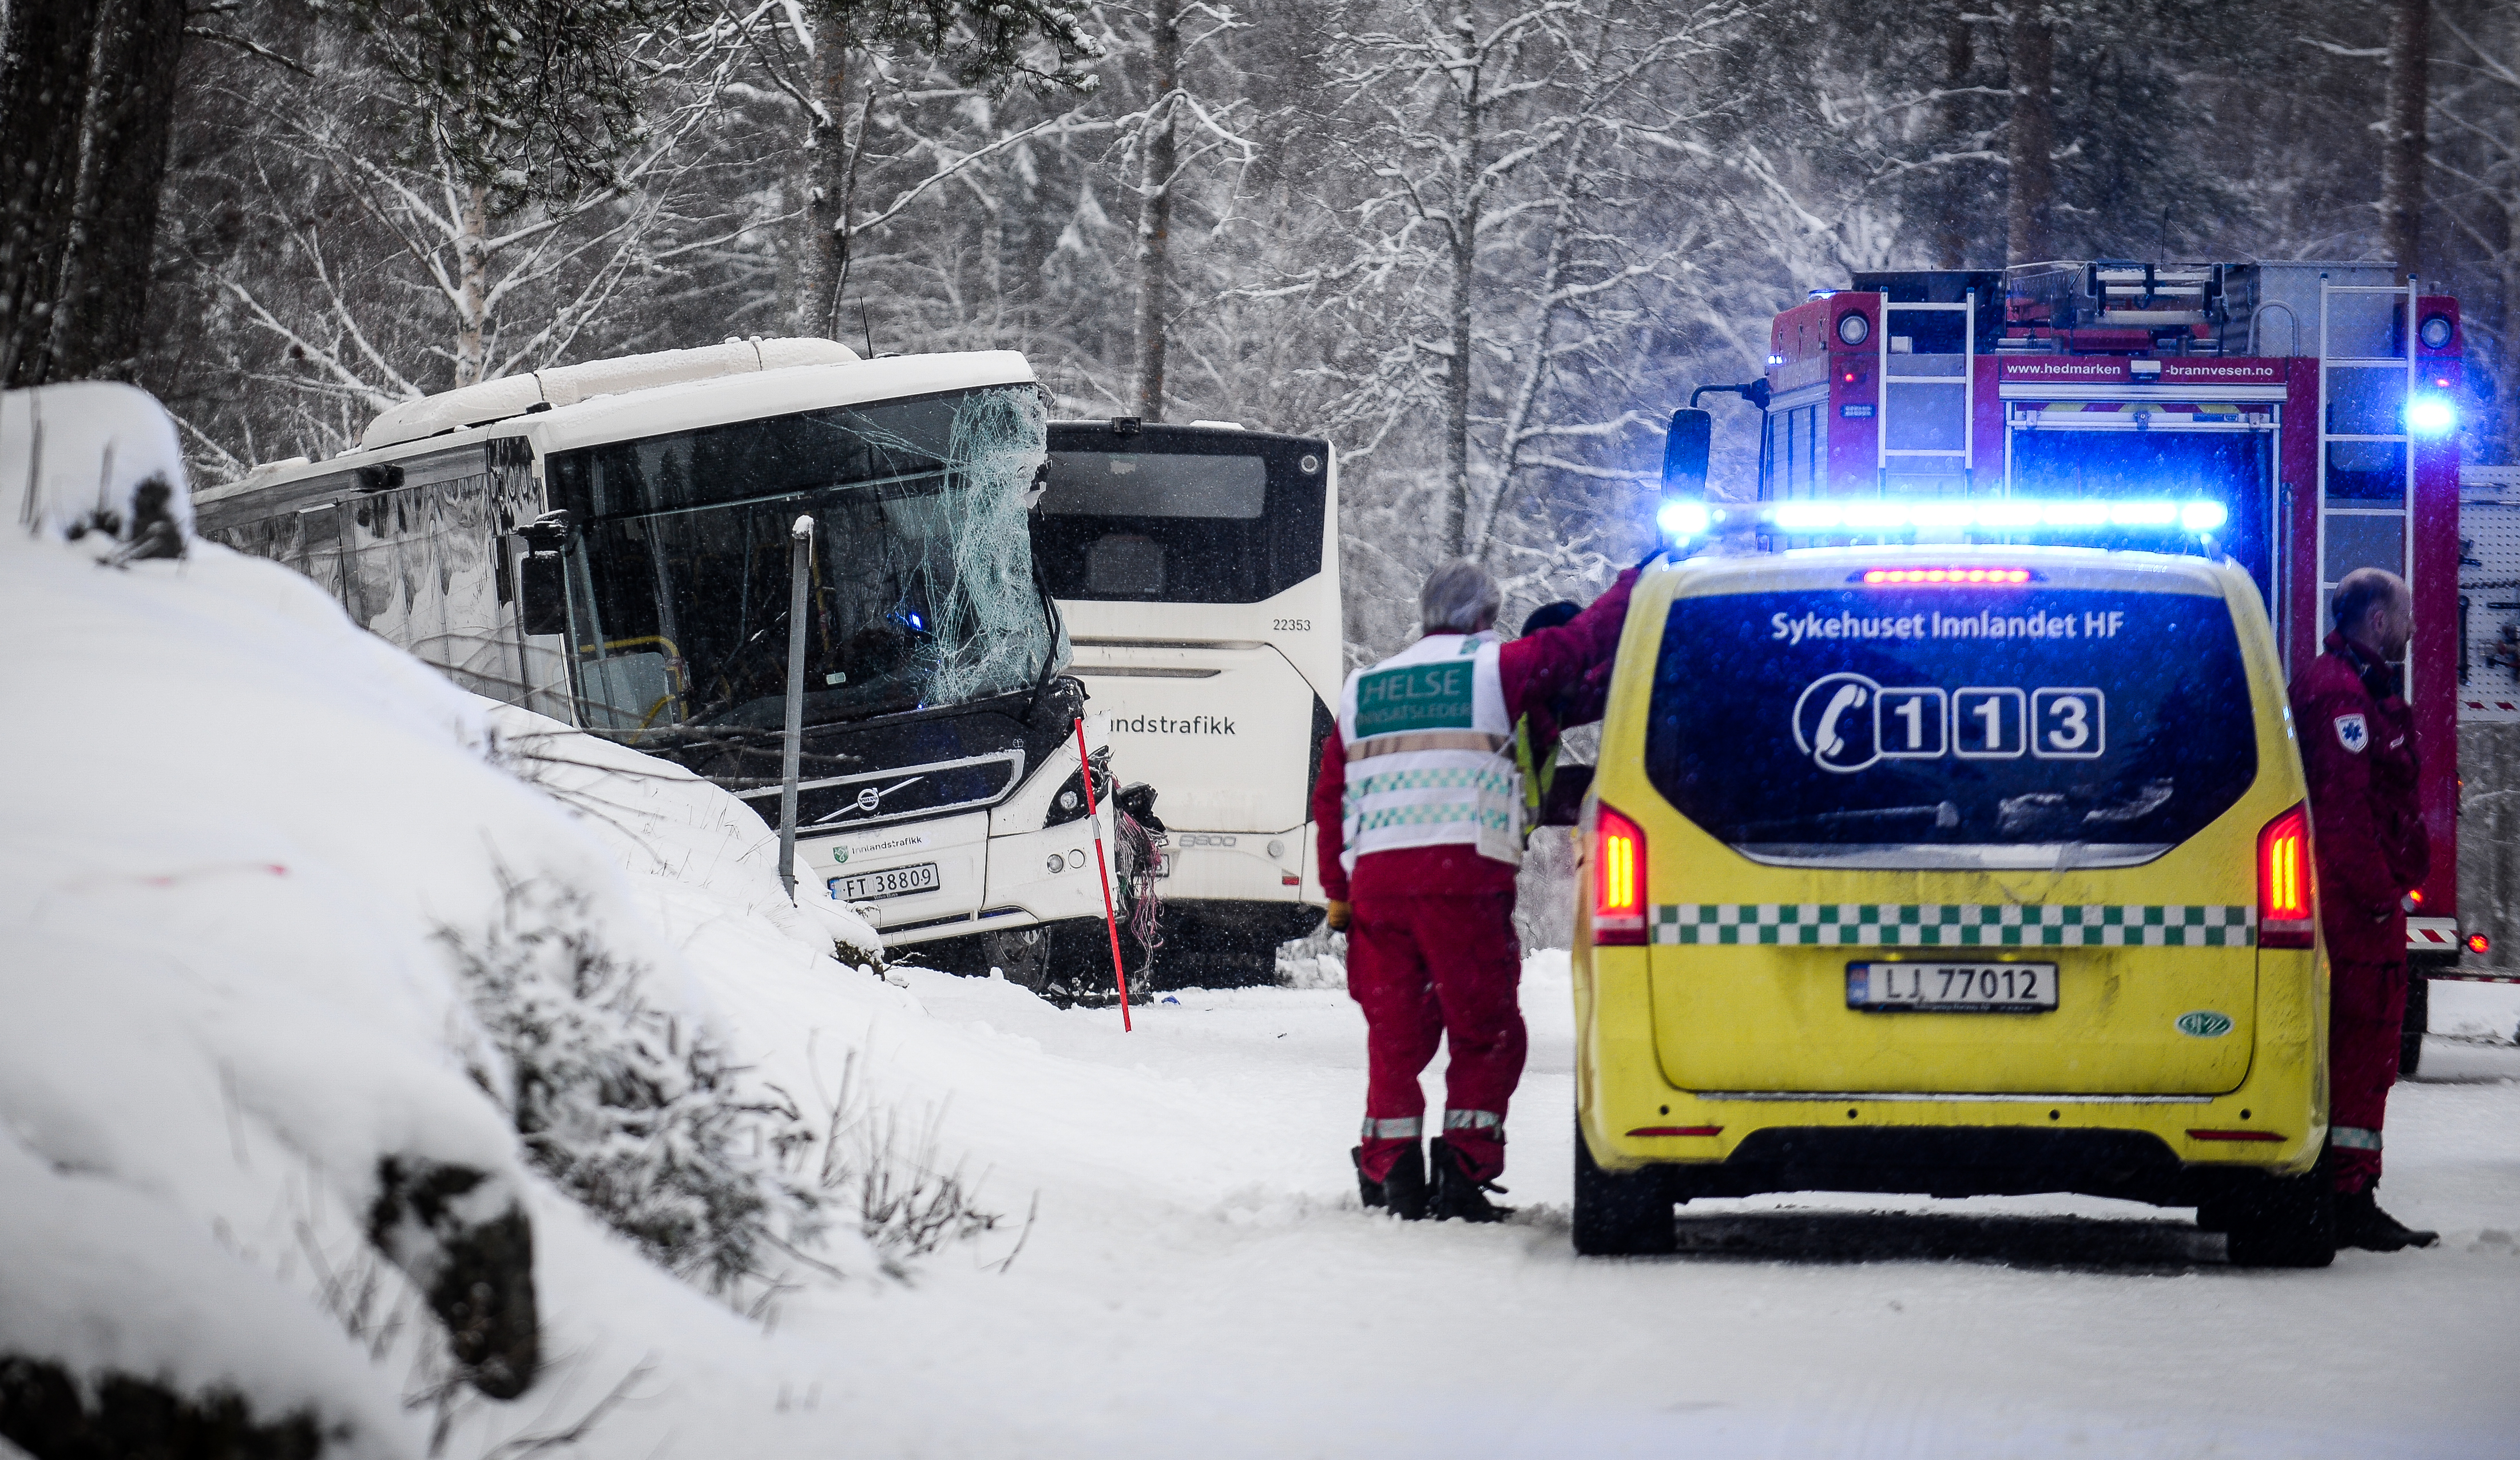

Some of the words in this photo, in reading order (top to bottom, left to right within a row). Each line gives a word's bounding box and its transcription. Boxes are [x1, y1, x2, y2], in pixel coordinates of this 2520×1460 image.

[2006, 362, 2121, 375] www.hedmarken
[2165, 364, 2273, 376] -brannvesen.no
[1273, 618, 1311, 631] 22353
[1771, 610, 1926, 646] Sykehuset
[1931, 610, 2078, 640] Innlandet
[2084, 610, 2125, 639] HF
[1362, 669, 1461, 705] HELSE
[852, 836, 922, 854] Innlandstrafikk
[846, 878, 867, 897] FT
[875, 868, 931, 892] 38809
[1887, 969, 1922, 998] LJ
[1938, 969, 2038, 999] 77012
